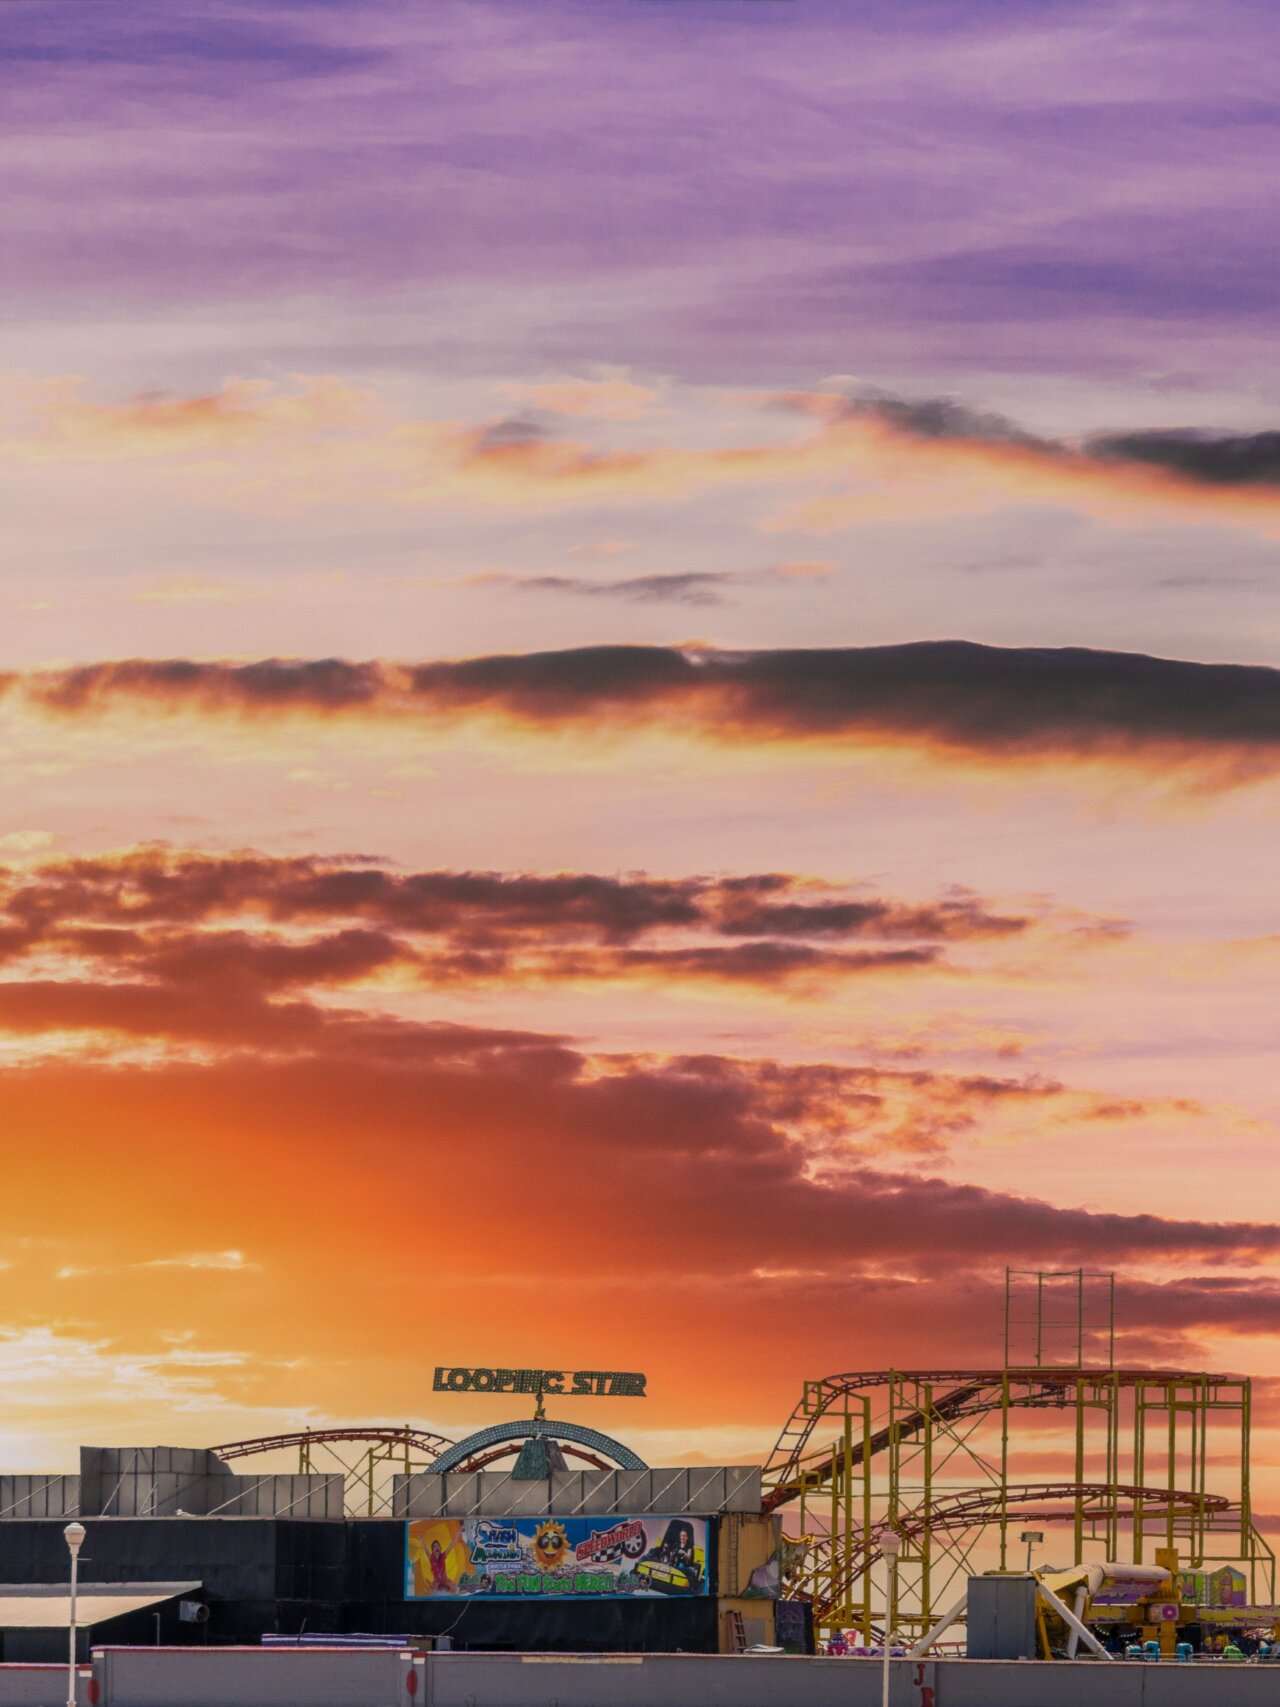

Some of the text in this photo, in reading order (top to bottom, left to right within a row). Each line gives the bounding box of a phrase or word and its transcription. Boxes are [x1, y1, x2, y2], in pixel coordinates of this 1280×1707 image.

[432, 1367, 648, 1397] LOOPING STAR
[577, 1521, 641, 1560] SPEEDWORLD
